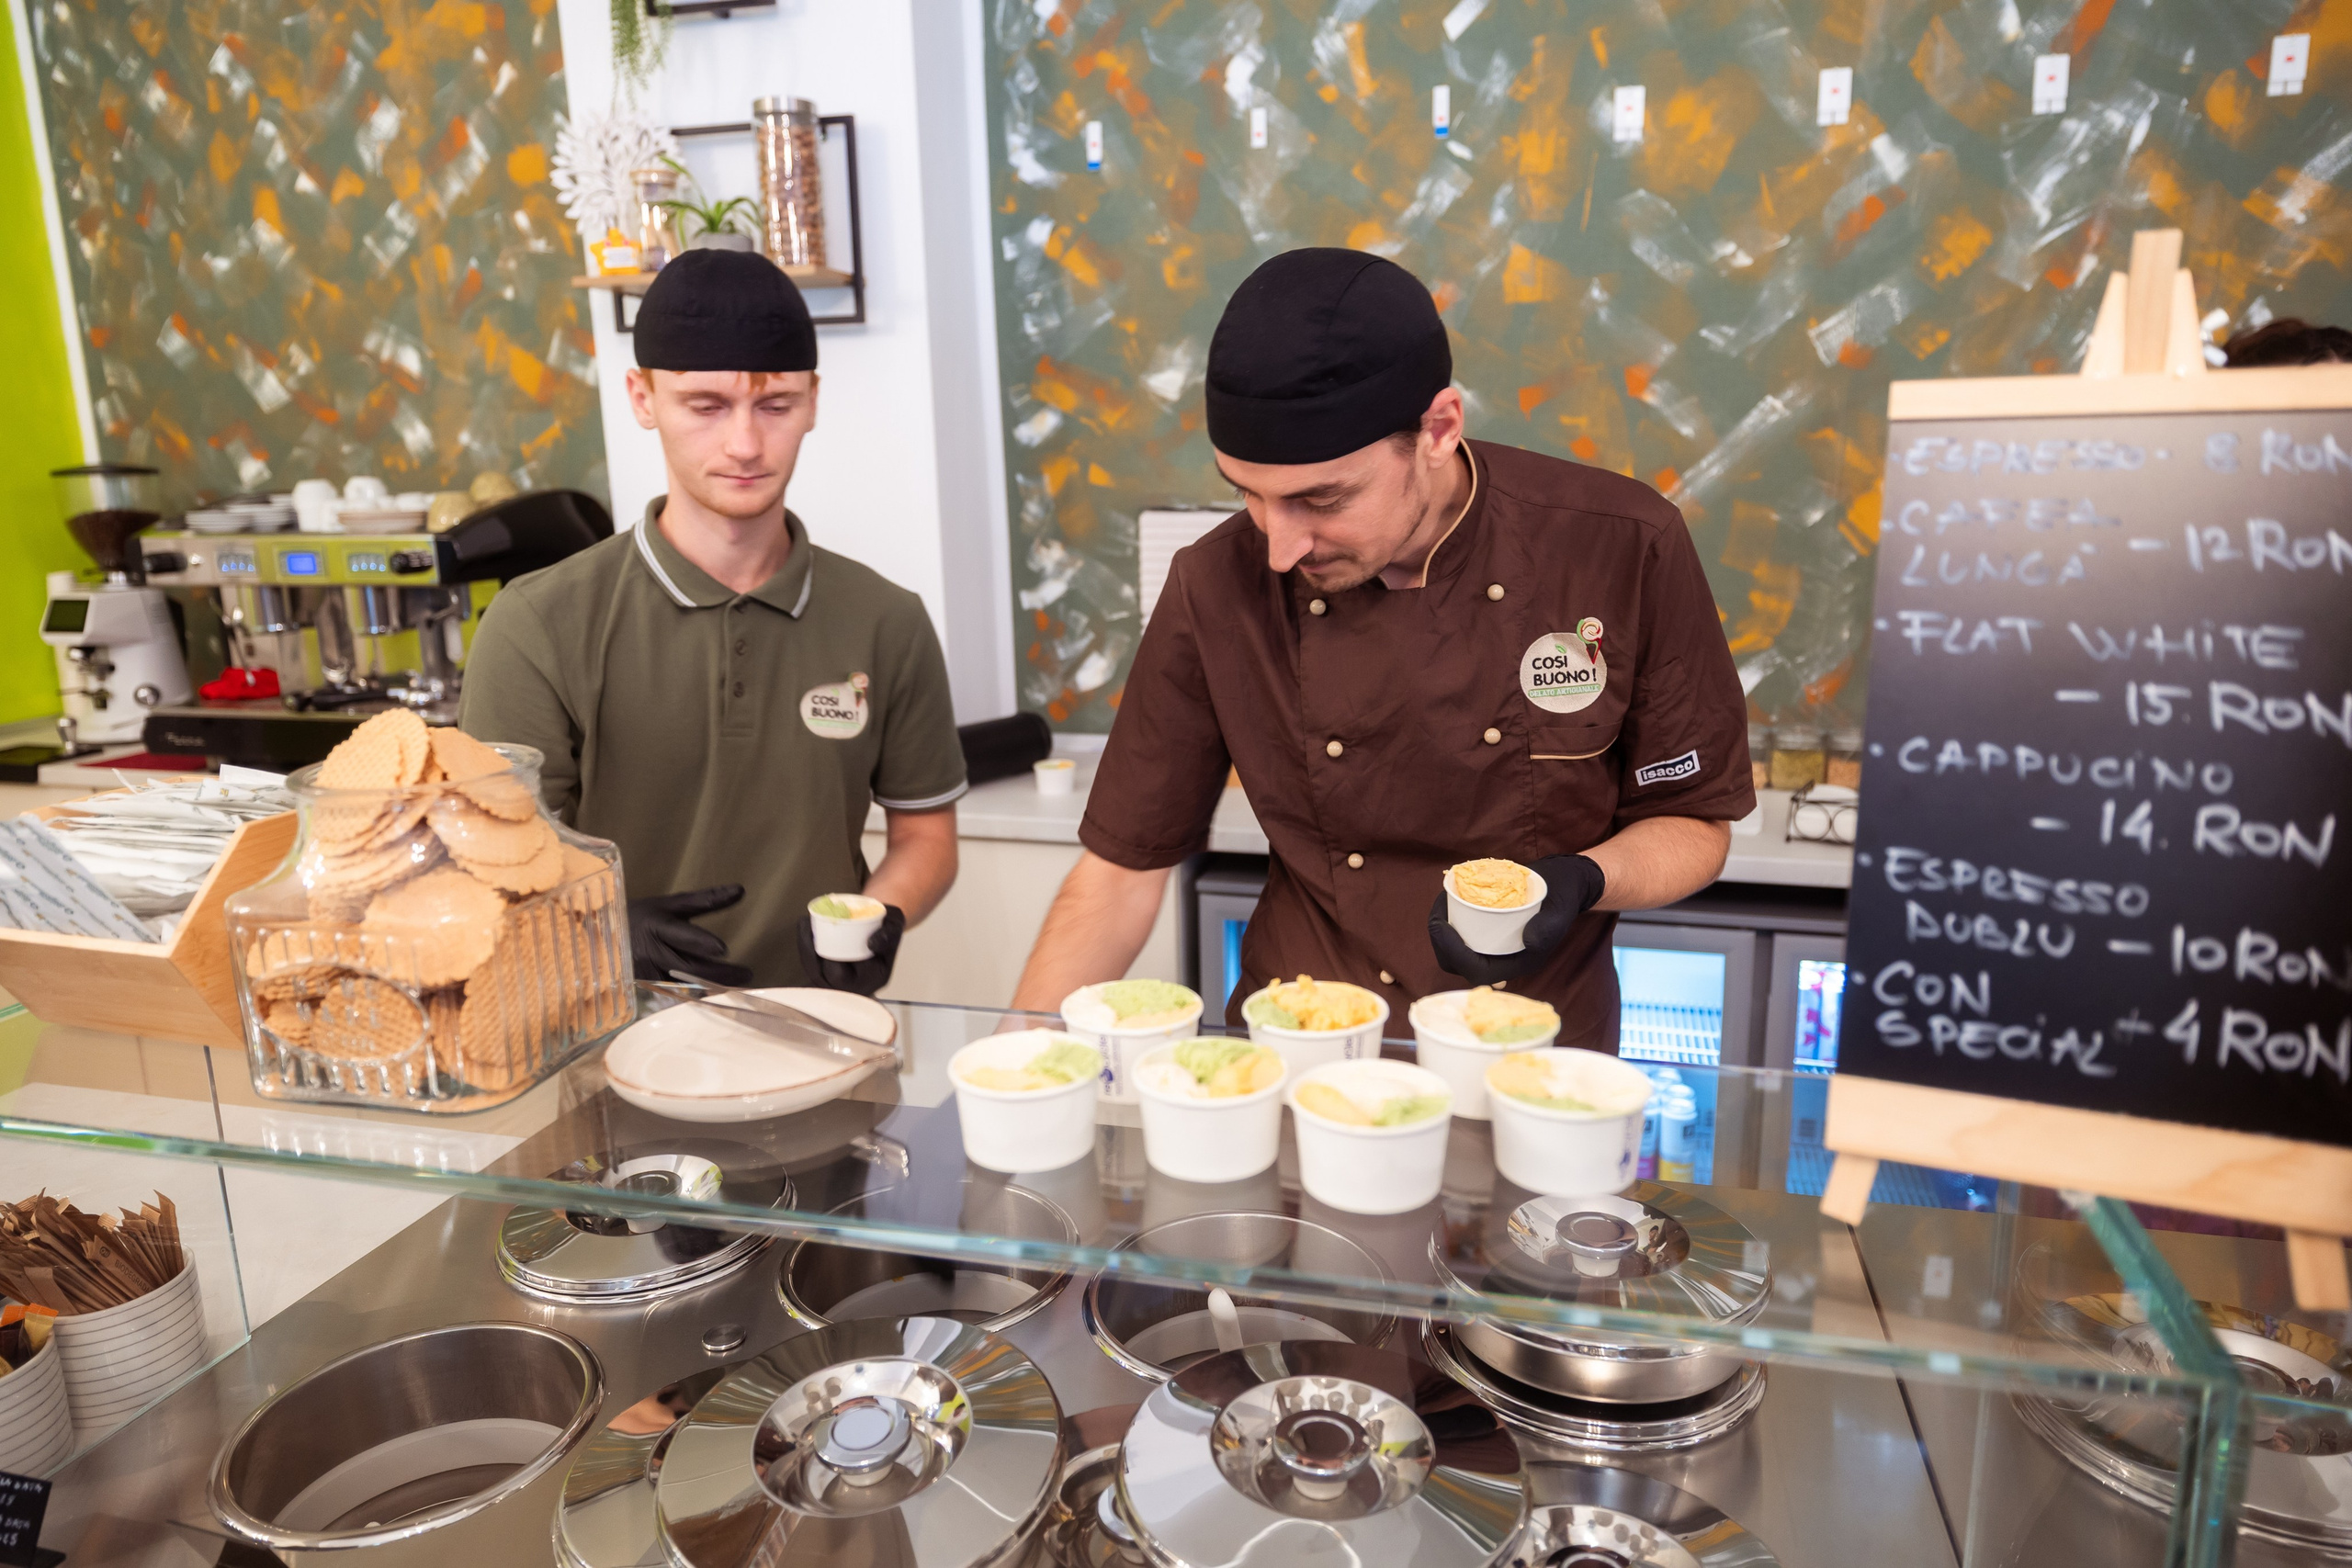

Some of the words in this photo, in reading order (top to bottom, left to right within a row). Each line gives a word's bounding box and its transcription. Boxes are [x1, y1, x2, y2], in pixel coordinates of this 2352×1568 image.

[1904, 436, 2147, 475] ESPRESSO
[1899, 497, 2120, 536] CAFEA
[2185, 523, 2242, 573] 12
[1897, 610, 2045, 656] FLAT
[2209, 680, 2352, 750] RON
[1642, 759, 1694, 781] isacco
[2193, 802, 2337, 868] RON
[1884, 846, 2151, 917] ESPRESSO
[1905, 899, 2076, 958] DUBLU
[2171, 922, 2228, 976] 10
[2235, 927, 2352, 993] RON
[1873, 960, 1992, 1018] CON
[2217, 1007, 2352, 1085] RON
